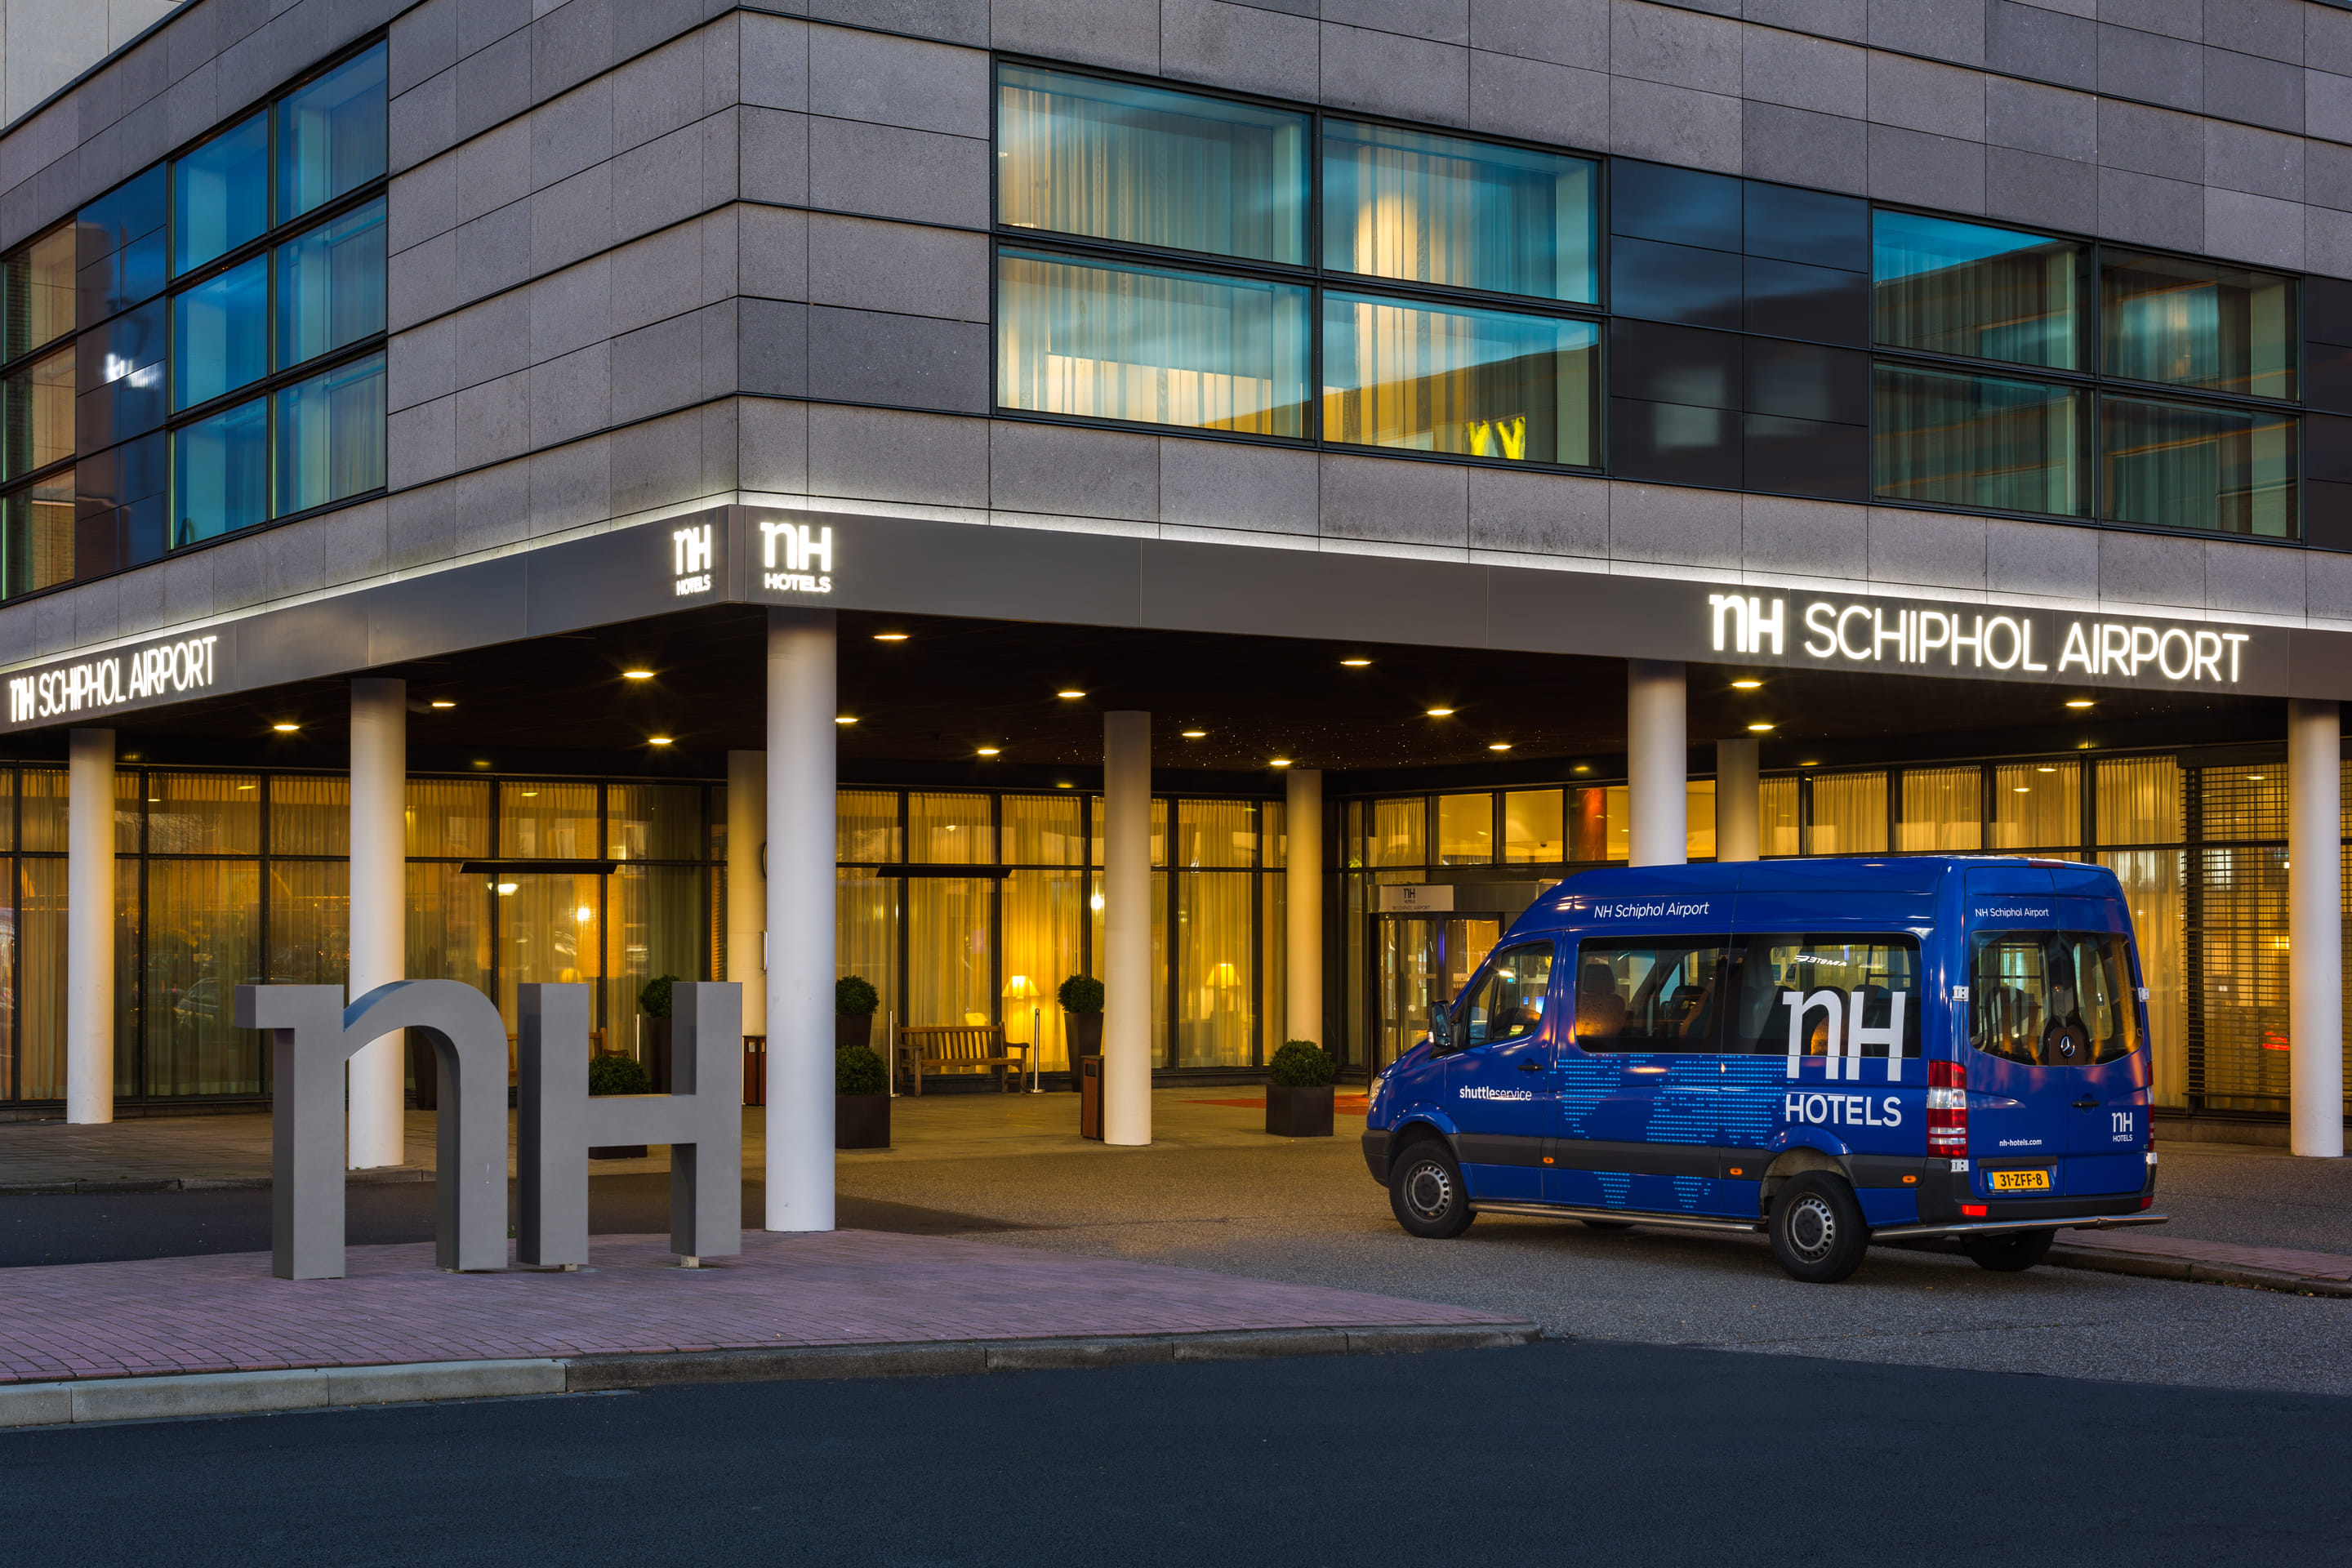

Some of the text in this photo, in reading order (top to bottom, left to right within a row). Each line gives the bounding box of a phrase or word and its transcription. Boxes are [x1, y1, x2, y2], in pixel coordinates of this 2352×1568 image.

[675, 574, 711, 596] HOTELS
[764, 572, 832, 593] HOTELS
[1804, 602, 2047, 671] SCHIPHOL
[2058, 621, 2250, 683] AIRPORT
[38, 657, 126, 717] SCHIPHOL
[129, 635, 217, 700] AIRPORT
[1594, 901, 1710, 920] NH Schiphol Airport
[1975, 907, 2049, 918] NH Schiphol Airport
[1459, 1085, 1532, 1101] shuttleservice
[1785, 1094, 1902, 1127] HOTELS
[1998, 1138, 2042, 1147] nh-hotels.com
[2112, 1134, 2133, 1143] HOTELS
[1999, 1173, 2043, 1187] 31-ZFF-8
